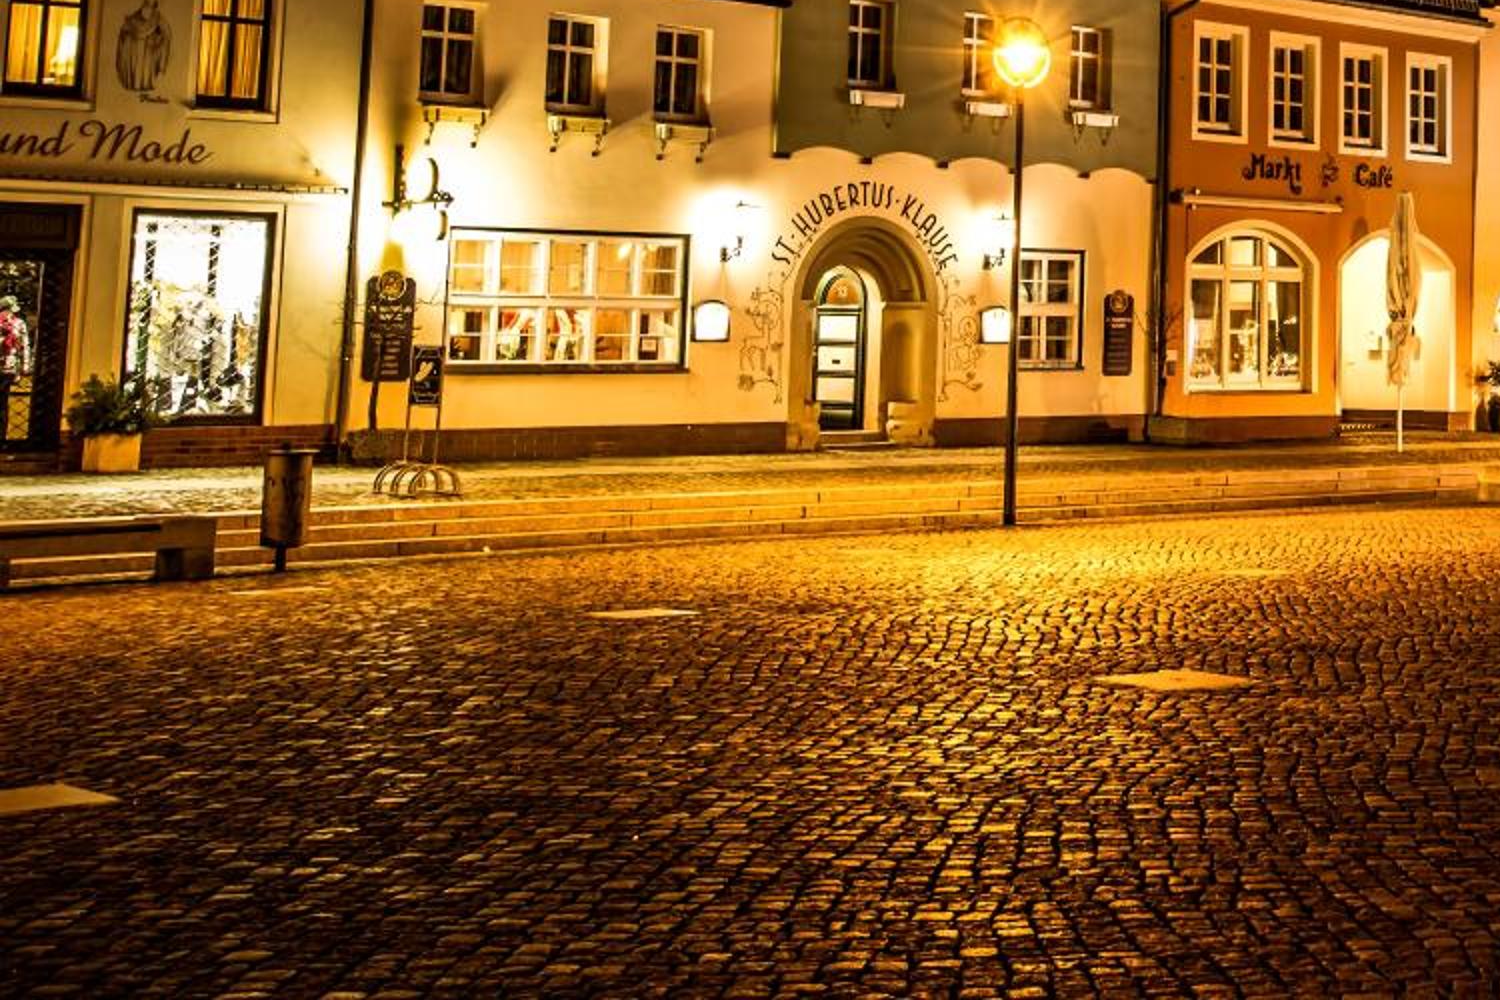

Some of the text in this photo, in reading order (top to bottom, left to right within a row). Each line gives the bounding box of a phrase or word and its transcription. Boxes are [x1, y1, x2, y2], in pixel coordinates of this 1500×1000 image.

[79, 119, 215, 165] Mode
[1241, 152, 1393, 195] Markt Café
